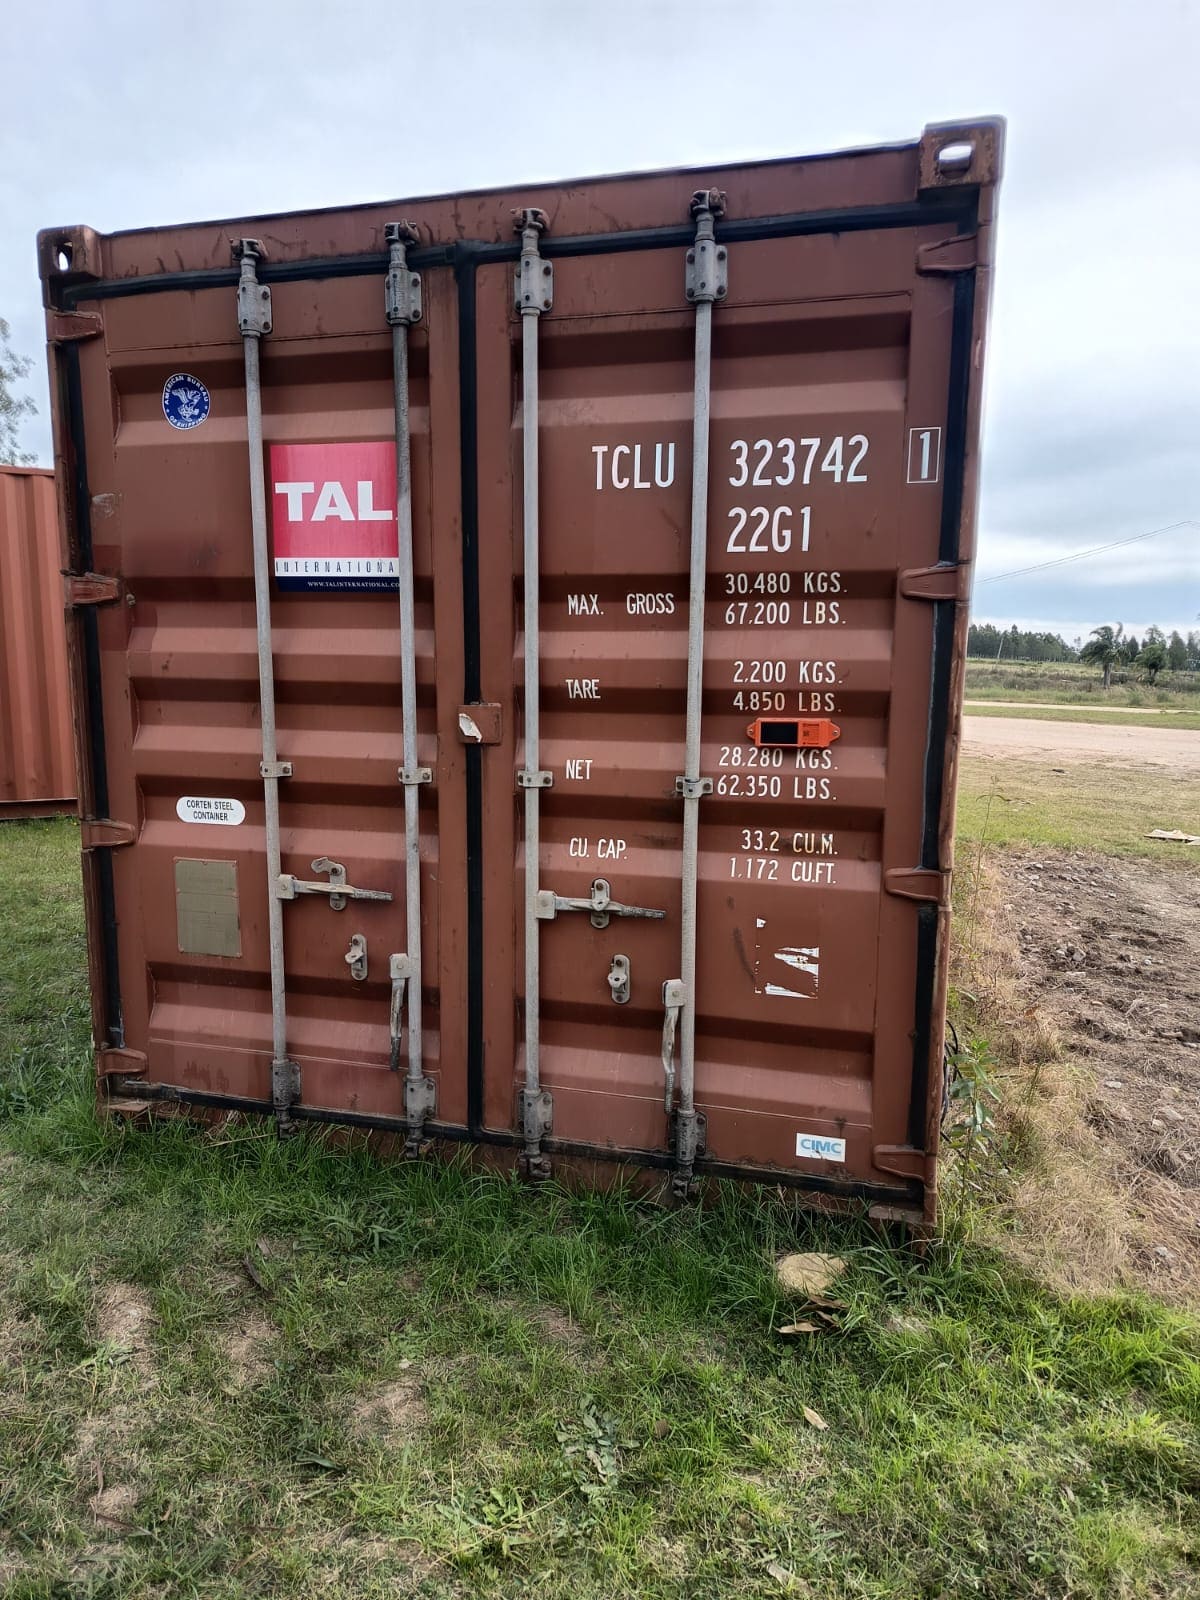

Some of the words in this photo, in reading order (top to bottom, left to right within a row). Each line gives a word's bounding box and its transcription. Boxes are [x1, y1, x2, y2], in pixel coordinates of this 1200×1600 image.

[592, 443, 675, 489] TCLU
[729, 434, 869, 487] 323742
[920, 431, 931, 480] 1
[726, 506, 811, 553] 22G1
[276, 561, 394, 573] INTERNATIONA
[725, 572, 790, 594] 30,480
[804, 572, 848, 593] KGS.
[567, 594, 604, 615] MAX.
[626, 593, 675, 614] GROSS
[725, 602, 790, 624] 67,200
[803, 602, 847, 624] LBS.
[733, 661, 786, 683] 2,200
[799, 661, 843, 683] KGS.
[565, 679, 601, 699] TARE
[733, 691, 785, 711] 4,850
[798, 692, 842, 712] LBS.
[719, 746, 783, 767] 28,280
[795, 749, 838, 770] KGS.
[565, 759, 593, 780] NET
[717, 775, 781, 797] 62,350
[794, 777, 837, 800] LBS.
[186, 800, 212, 809] CORTEN
[214, 801, 234, 811] STEEL
[193, 810, 228, 821] CONTAINER
[569, 838, 590, 858] CU.
[597, 839, 628, 859] CAP.
[741, 829, 780, 852] 33.2
[792, 833, 838, 855] CU.M.
[730, 857, 779, 880] 1,172
[791, 861, 837, 884] CU.FT.
[800, 1138, 842, 1154] CIMC
